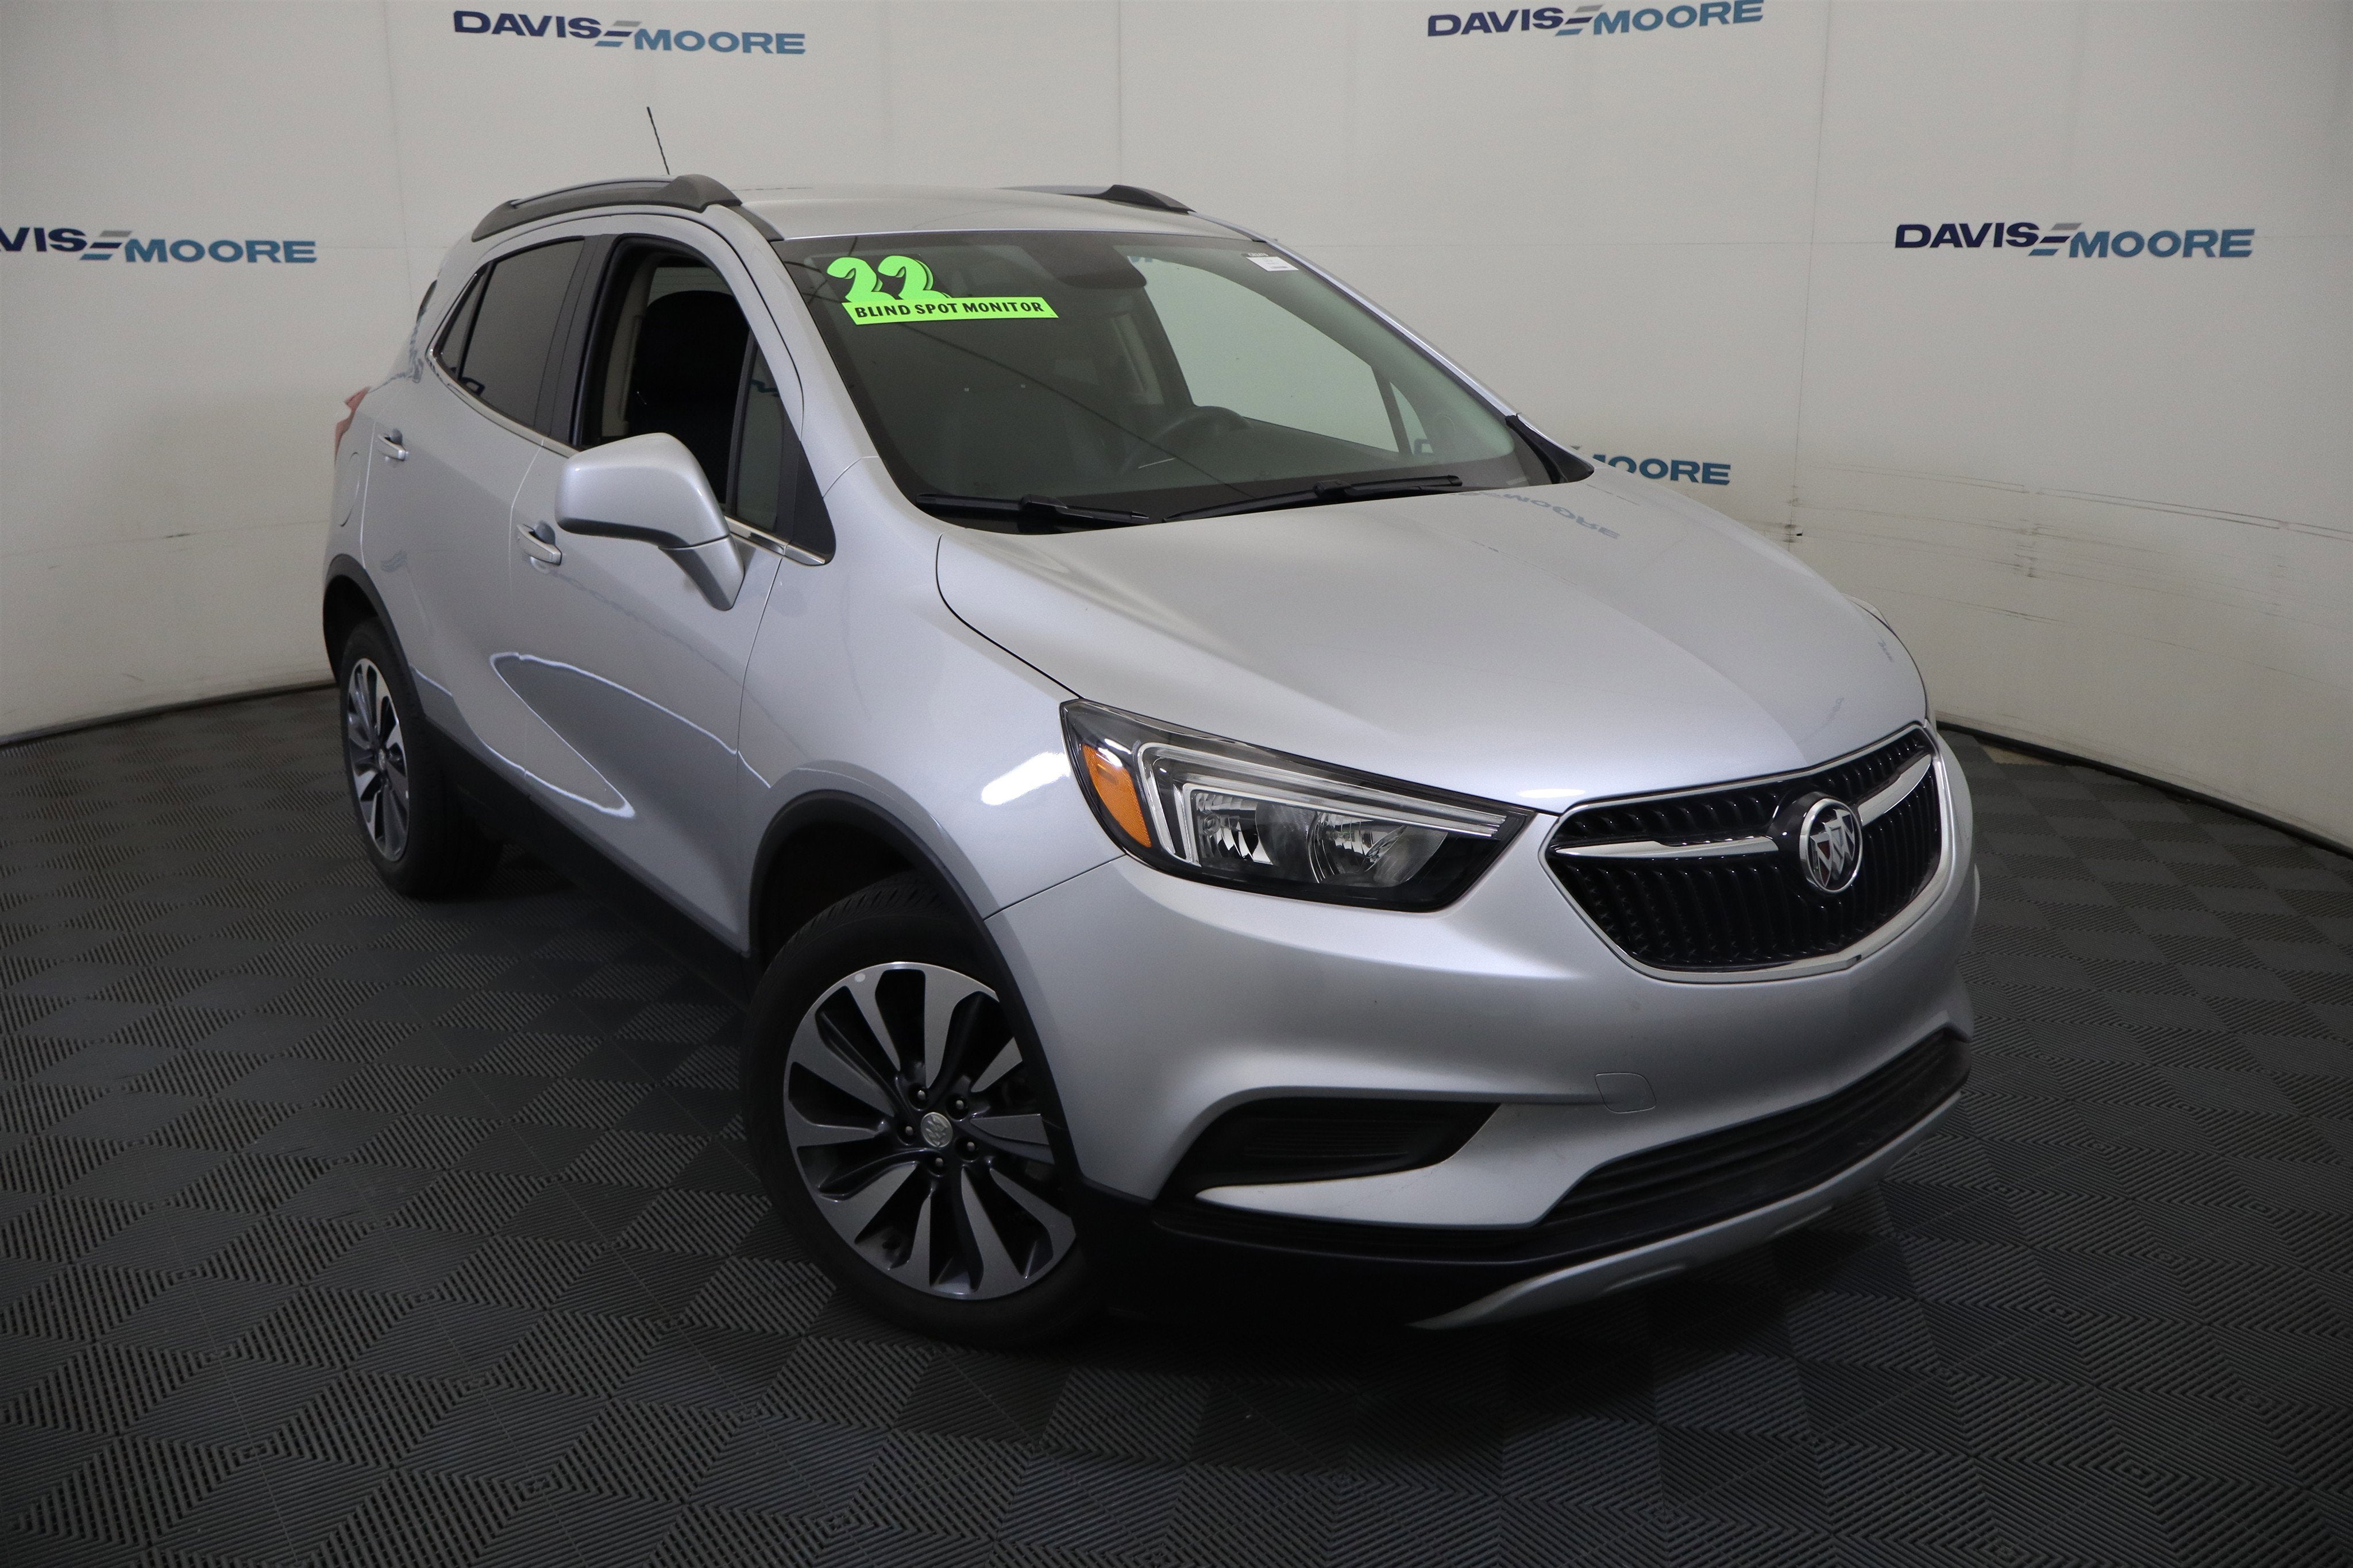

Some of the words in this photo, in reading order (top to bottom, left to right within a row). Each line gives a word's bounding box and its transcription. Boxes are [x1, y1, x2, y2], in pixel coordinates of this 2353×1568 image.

[453, 10, 602, 39] DAVIS
[634, 28, 805, 55] MOORE
[1428, 7, 1564, 37] DAVIS
[1593, 0, 1764, 36] MOORE
[0, 227, 87, 252] VIS
[124, 239, 317, 263] MOORE
[1895, 222, 2040, 249] DAVIS
[2069, 229, 2255, 258] MOORE
[827, 255, 952, 303] 22
[855, 306, 911, 318] BLIND
[916, 303, 958, 315] SPOT
[962, 302, 1045, 313] MONITOR
[1592, 454, 1731, 486] OORE
